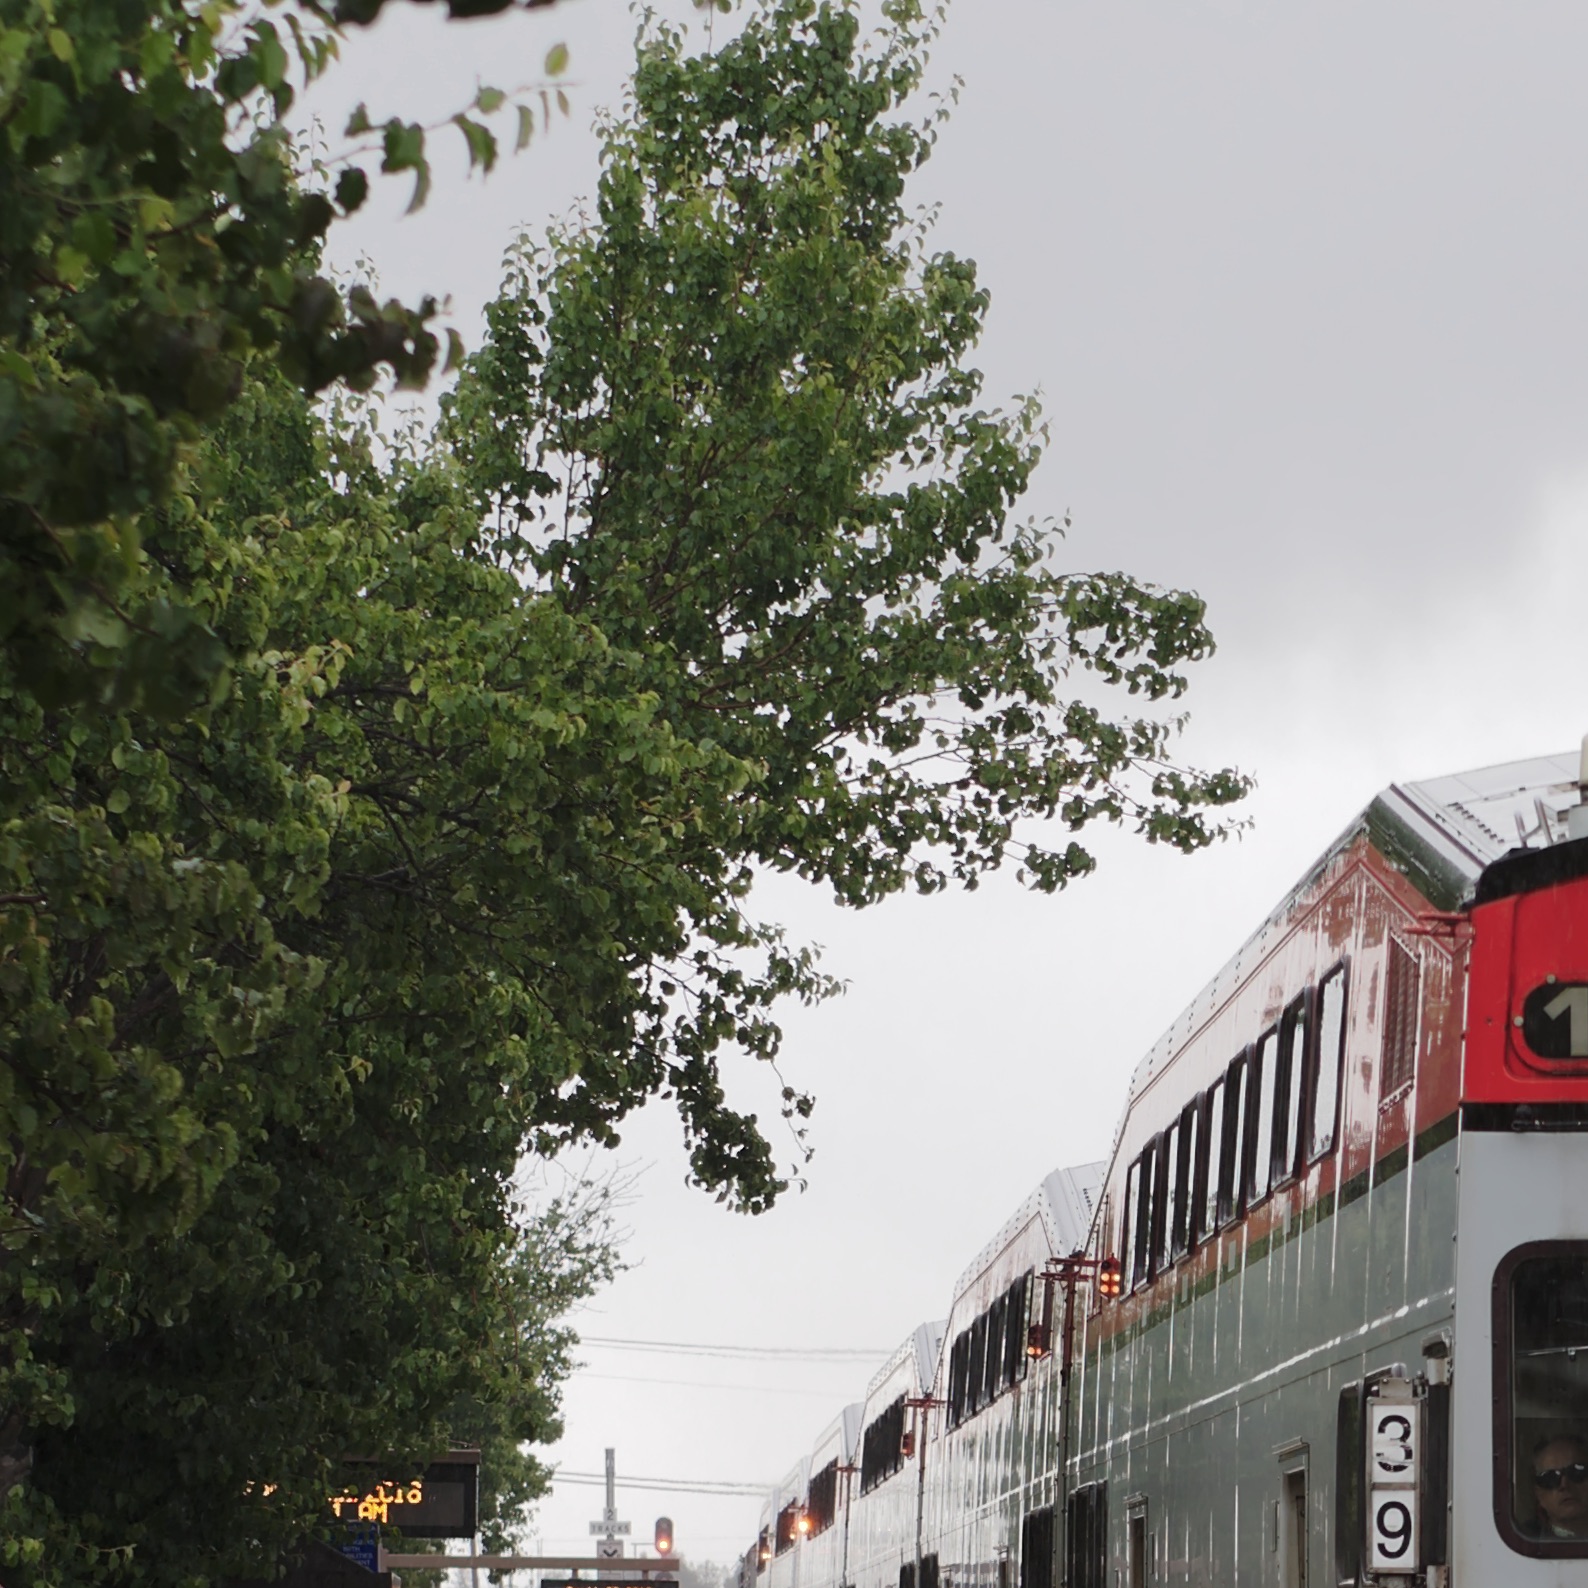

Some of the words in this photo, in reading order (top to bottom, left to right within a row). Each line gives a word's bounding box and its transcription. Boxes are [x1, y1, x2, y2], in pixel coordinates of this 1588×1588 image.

[358, 1502, 388, 1523] AM
[607, 1508, 614, 1521] 2
[592, 1524, 629, 1534] TRACKS
